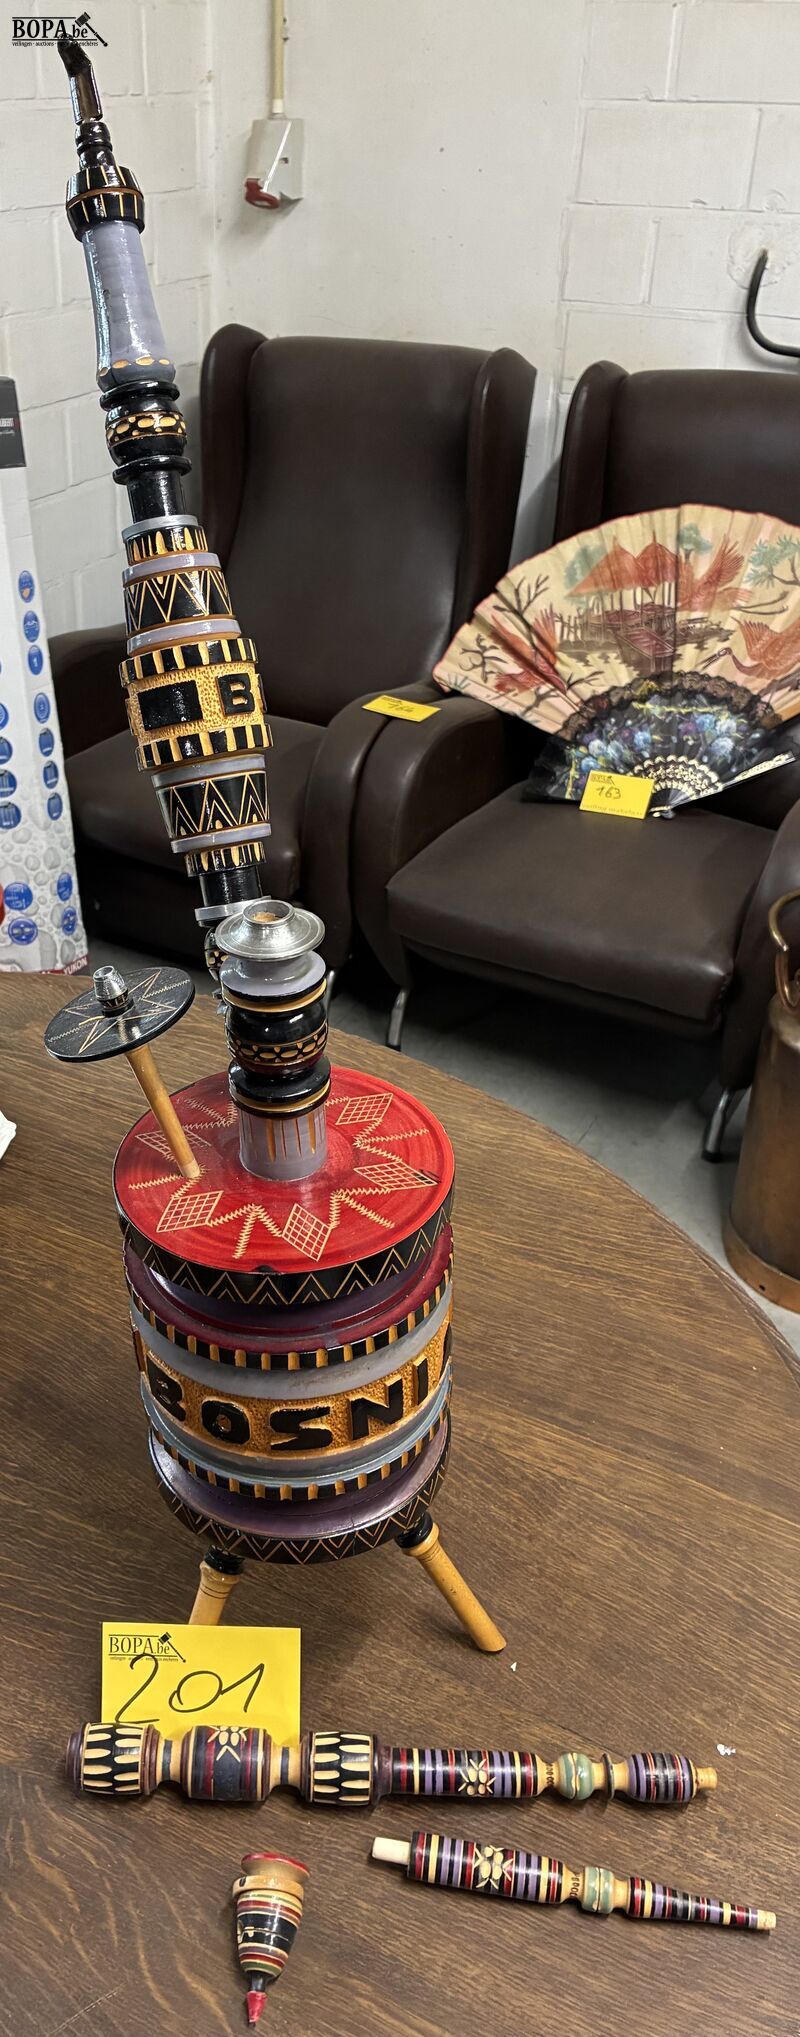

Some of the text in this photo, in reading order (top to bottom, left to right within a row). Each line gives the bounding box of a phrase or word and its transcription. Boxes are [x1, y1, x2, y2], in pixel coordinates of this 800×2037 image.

[596, 786, 622, 800] 163
[63, 956, 88, 976] YUKON
[109, 1636, 170, 1655] BOPA.be
[115, 1653, 265, 1724] 201
